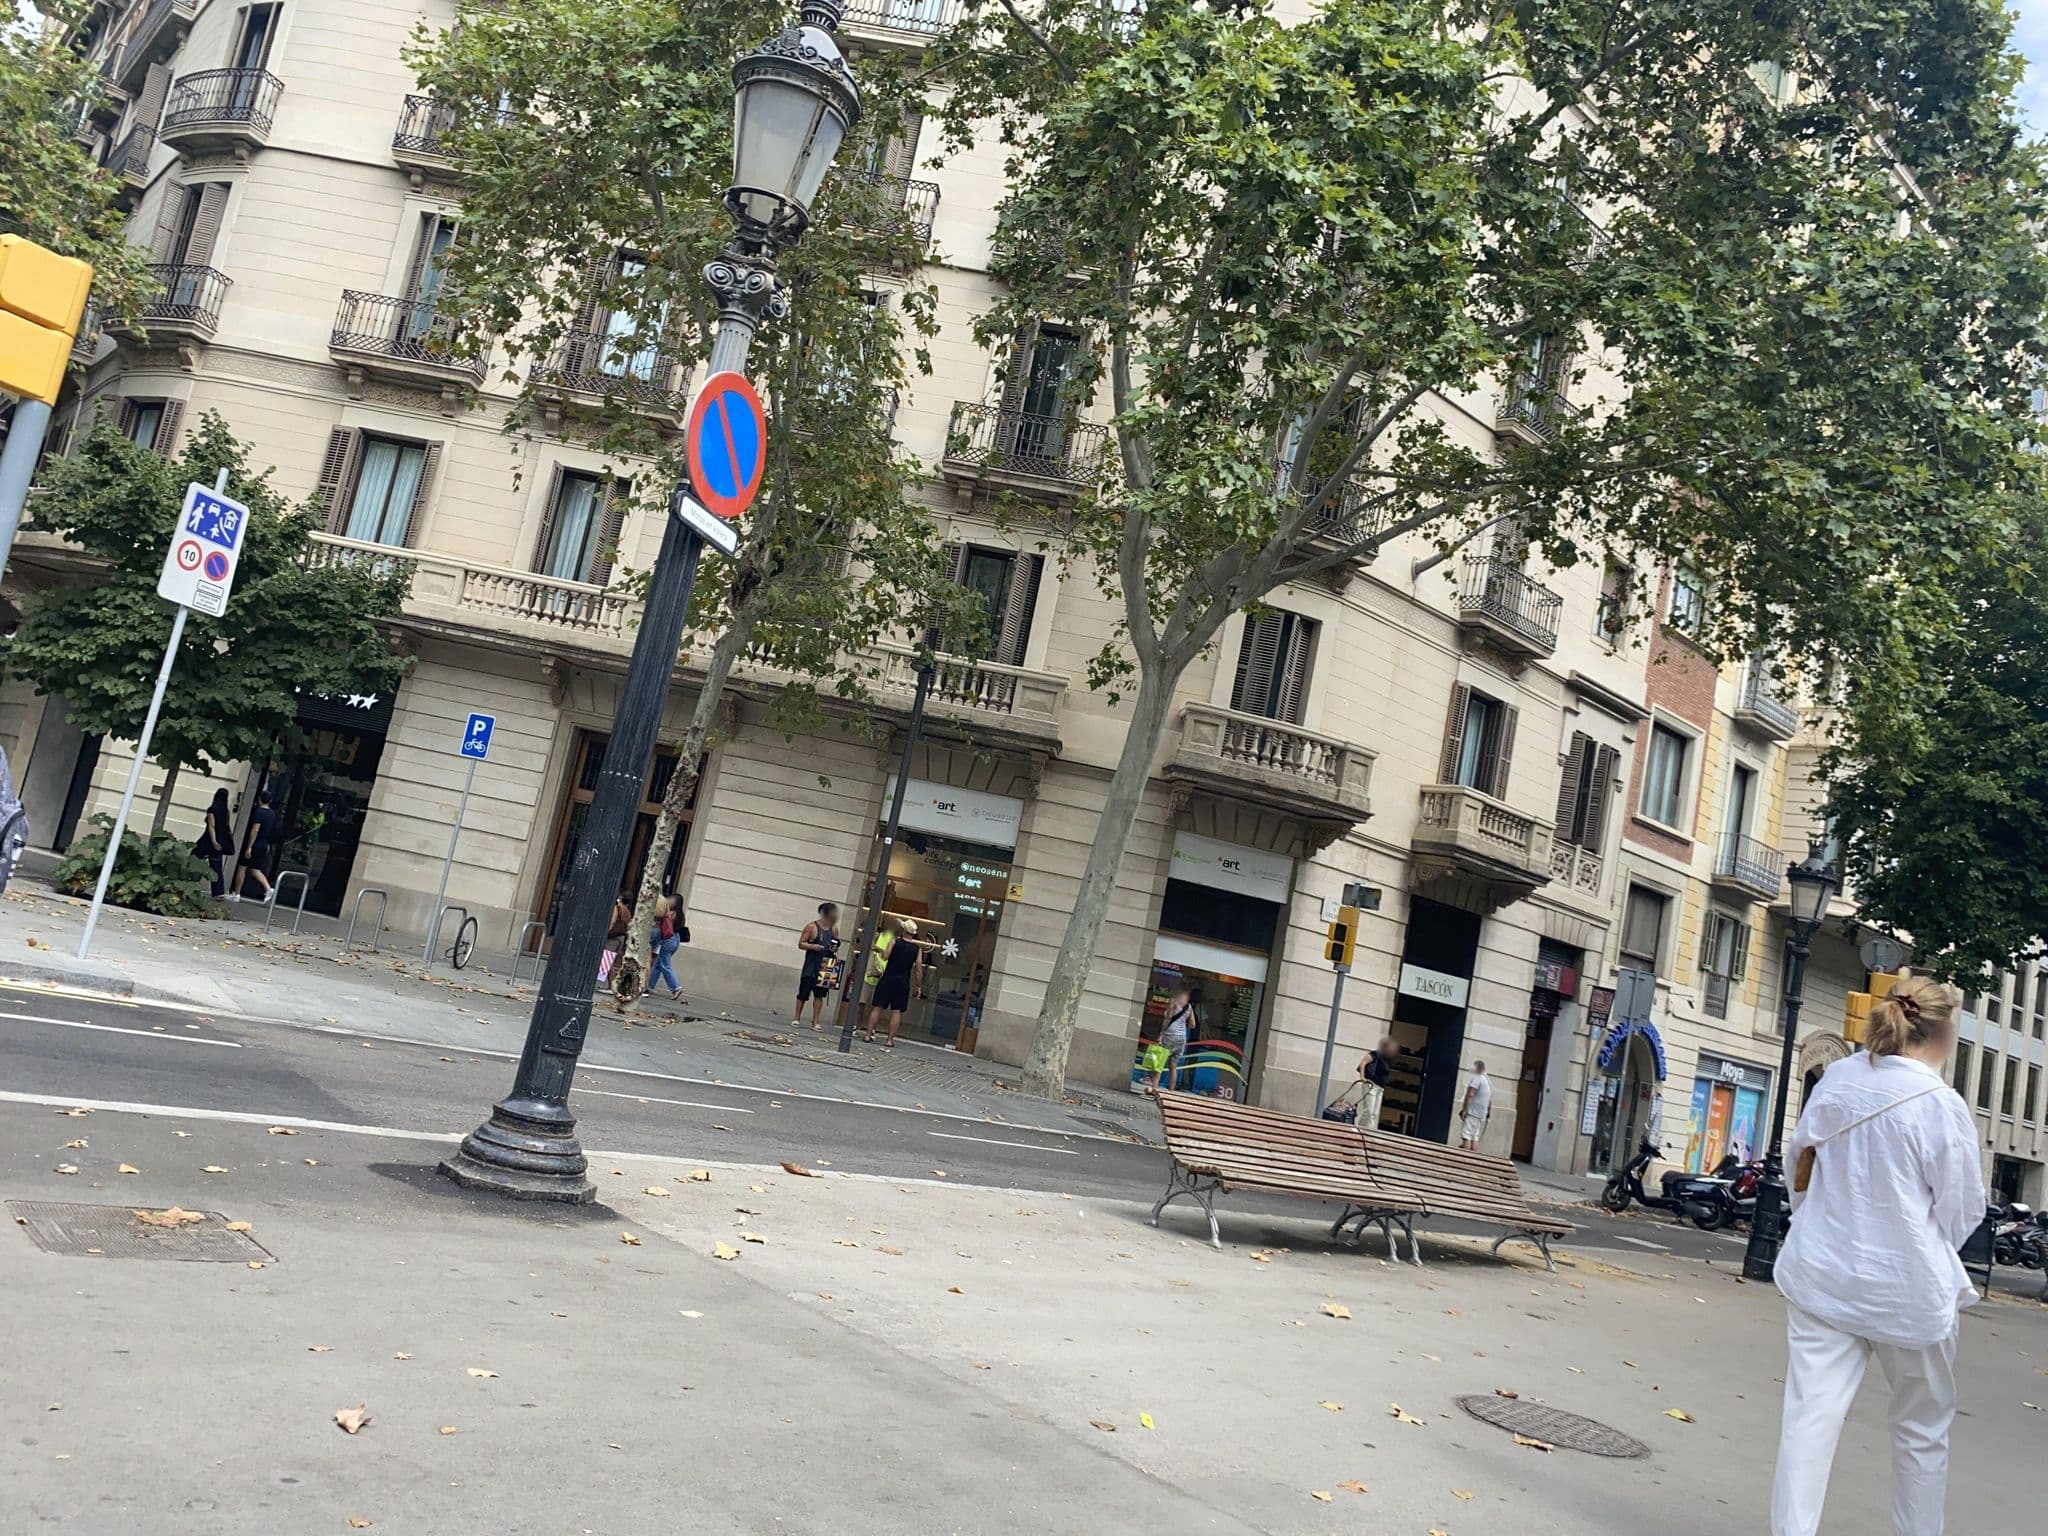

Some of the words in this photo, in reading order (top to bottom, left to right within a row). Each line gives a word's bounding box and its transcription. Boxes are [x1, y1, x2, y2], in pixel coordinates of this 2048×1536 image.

[184, 550, 196, 562] 10
[472, 720, 486, 736] P
[937, 800, 957, 812] art
[1222, 859, 1240, 870] art
[1416, 977, 1453, 997] TASCÓN
